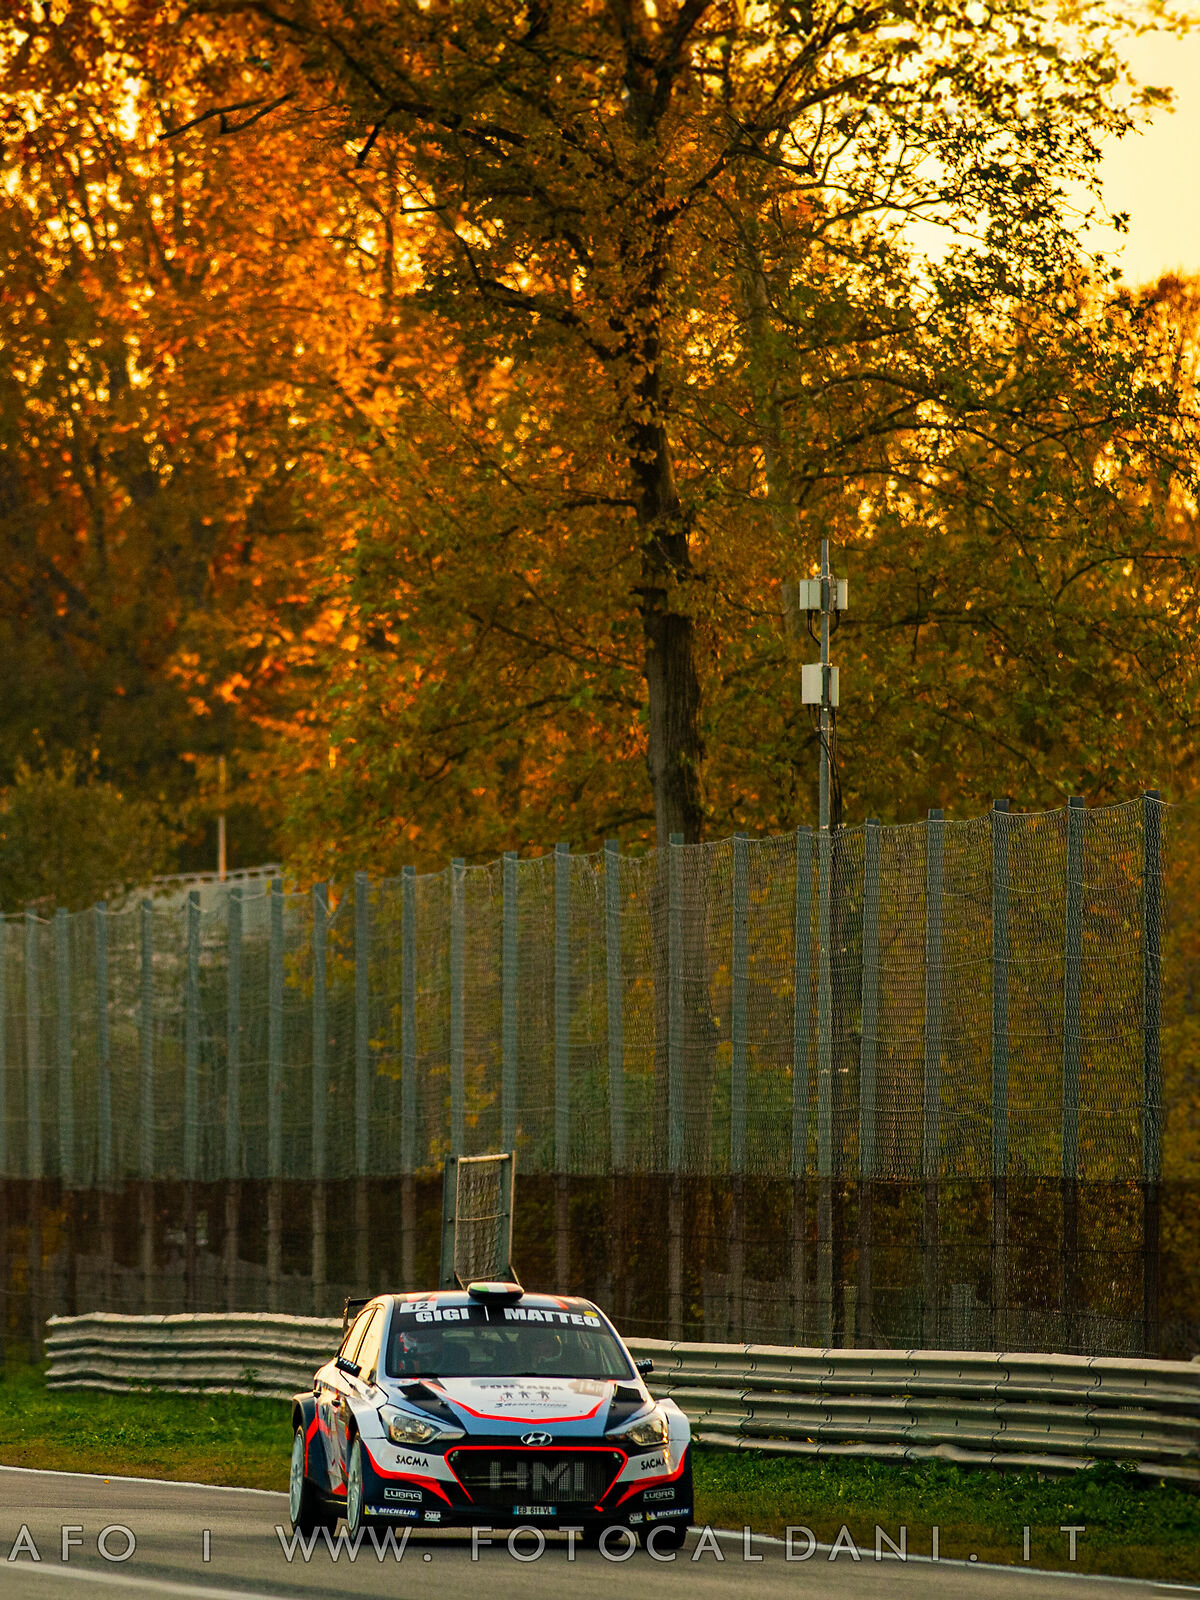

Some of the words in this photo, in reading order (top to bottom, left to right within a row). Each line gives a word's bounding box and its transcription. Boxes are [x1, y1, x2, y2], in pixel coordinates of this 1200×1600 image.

[410, 1302, 428, 1310] 12
[415, 1308, 470, 1323] GIGI
[504, 1308, 601, 1328] MATTEO
[395, 1455, 429, 1467] SACMA
[489, 1460, 584, 1491] HMI
[379, 1507, 416, 1516] MICHELIN
[657, 1508, 689, 1517] MICHELIN
